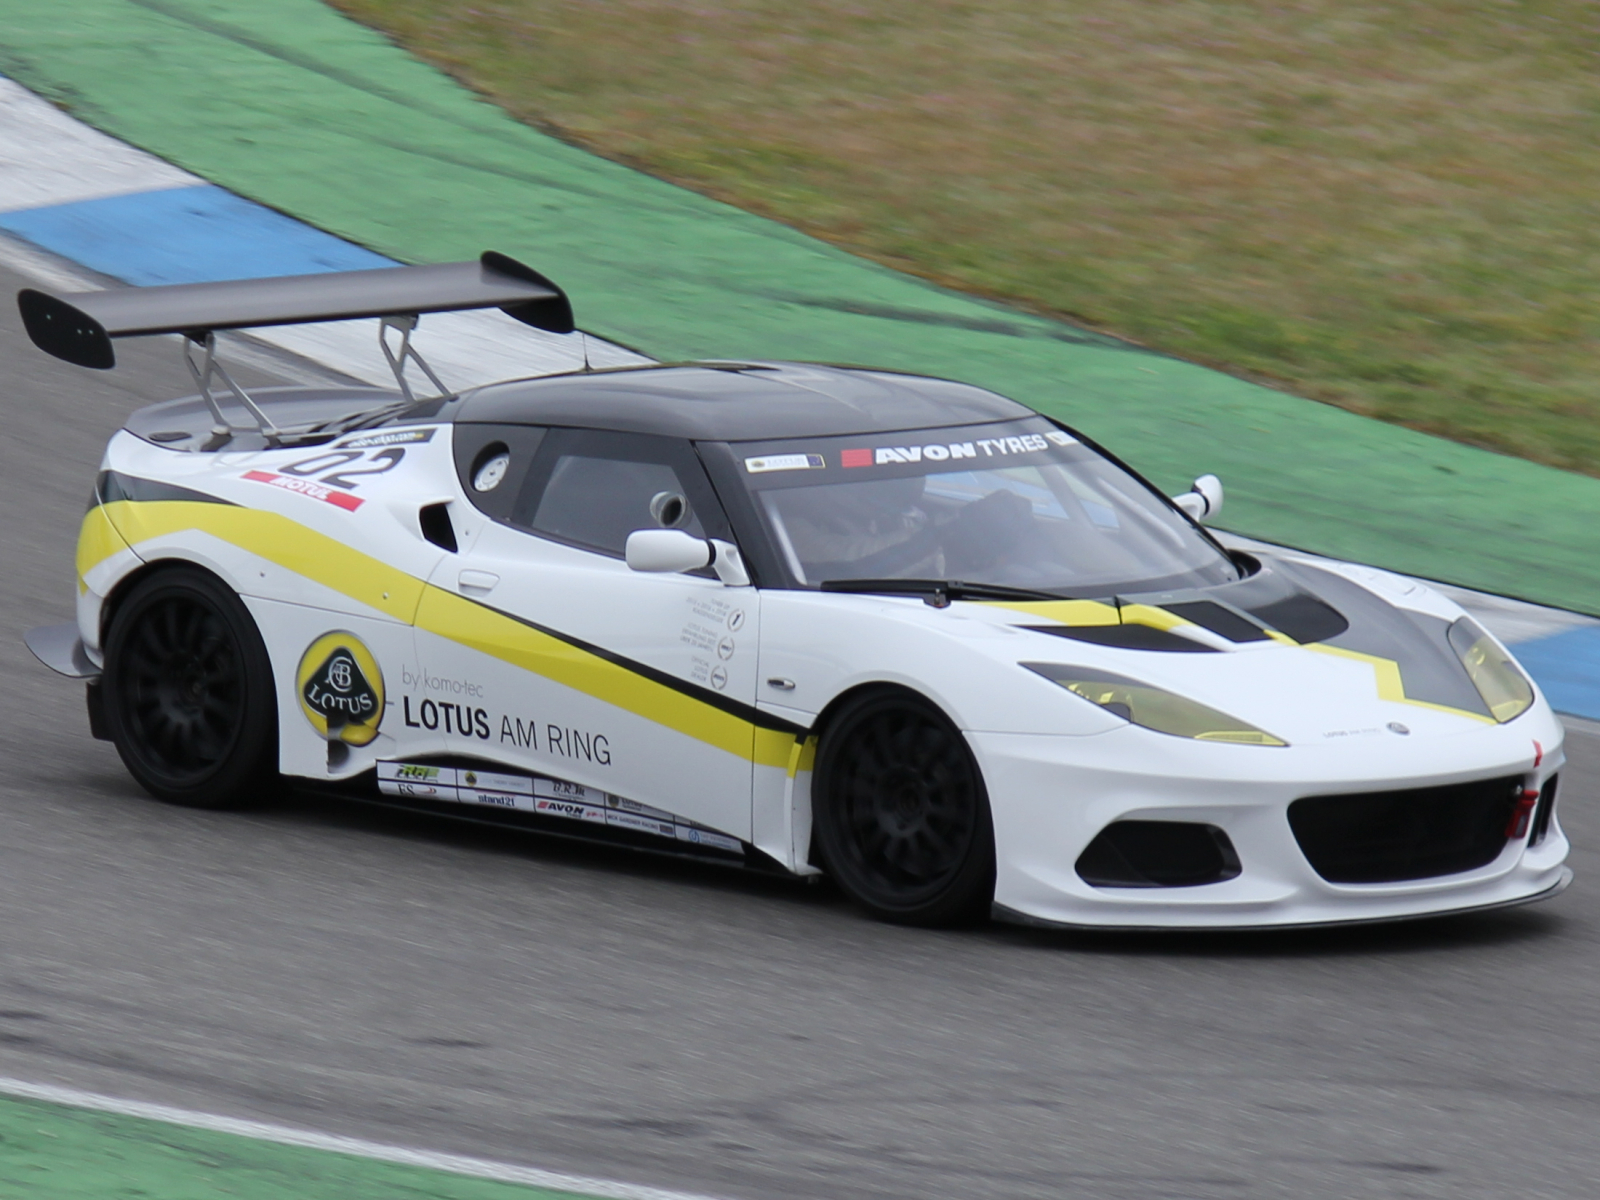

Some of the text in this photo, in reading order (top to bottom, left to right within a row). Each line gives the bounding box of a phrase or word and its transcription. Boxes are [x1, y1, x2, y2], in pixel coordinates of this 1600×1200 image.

[875, 433, 1048, 465] AVON TYRES
[277, 447, 405, 490] 02
[269, 476, 334, 500] MOTUL
[402, 664, 484, 698] by komo-tec
[307, 683, 373, 714] LOTUS
[403, 695, 612, 767] LOTUS AM RING
[478, 794, 515, 807] stand21
[548, 802, 584, 814] AVON
